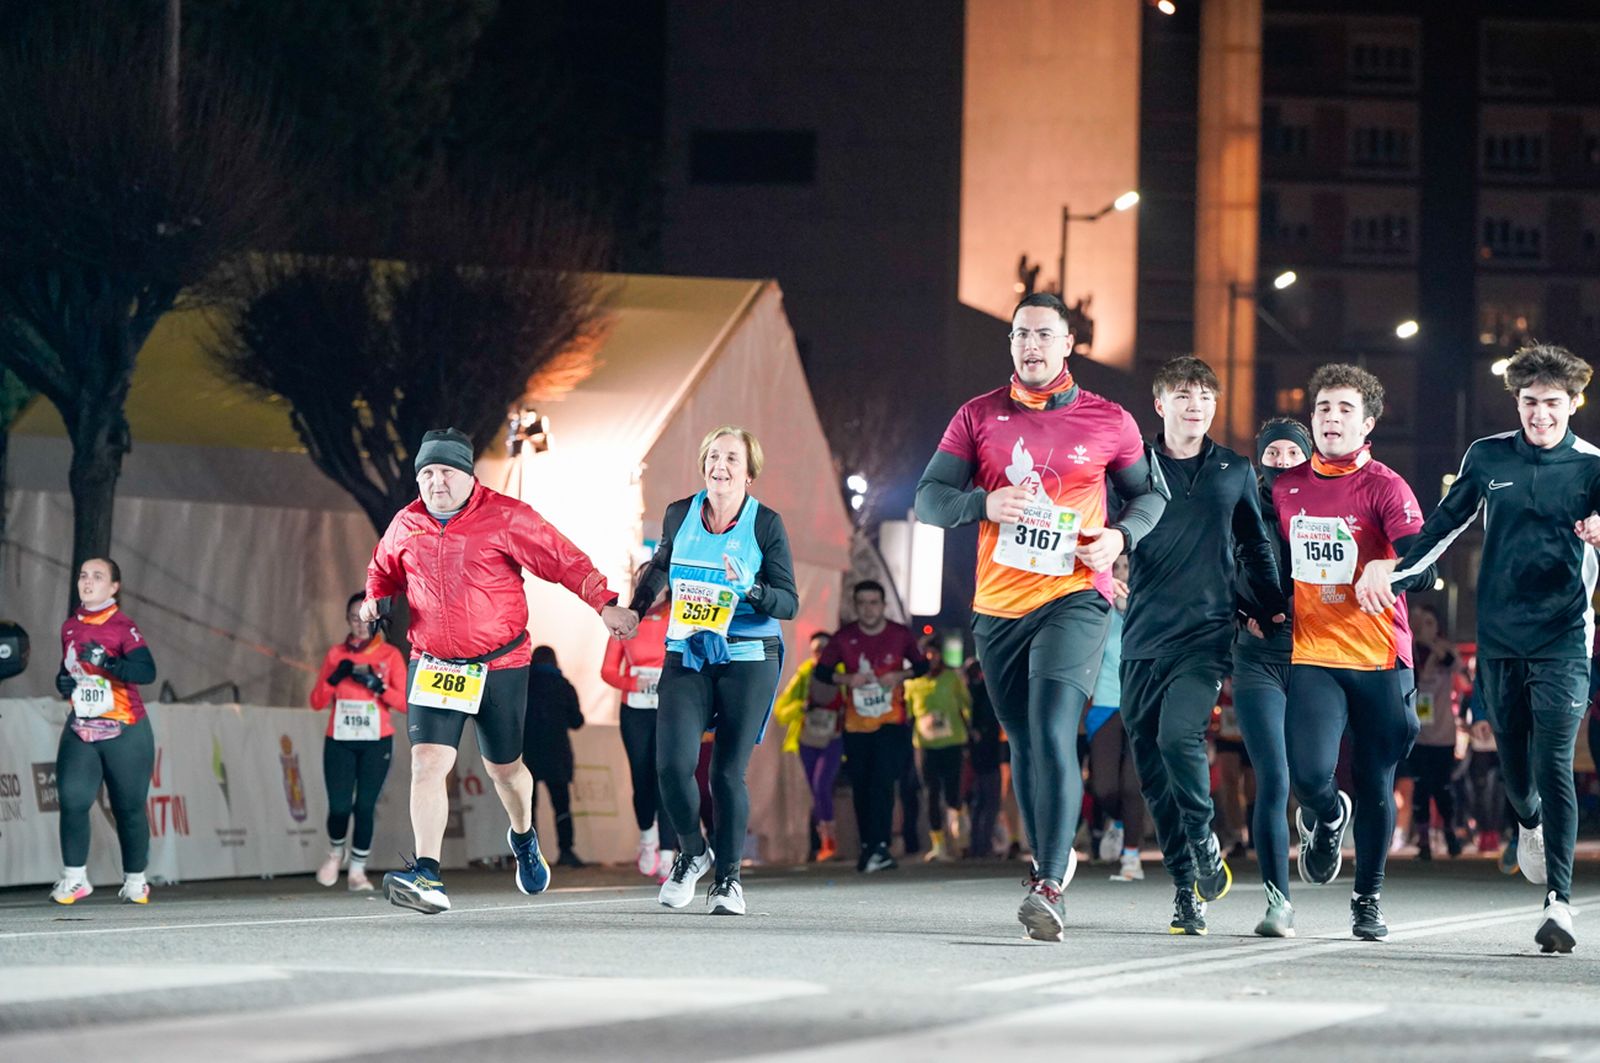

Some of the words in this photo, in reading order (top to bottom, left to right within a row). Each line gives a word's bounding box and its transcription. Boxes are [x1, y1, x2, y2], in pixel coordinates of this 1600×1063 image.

[1015, 524, 1061, 551] 3167
[1303, 541, 1344, 561] 1546
[431, 672, 466, 693] 268
